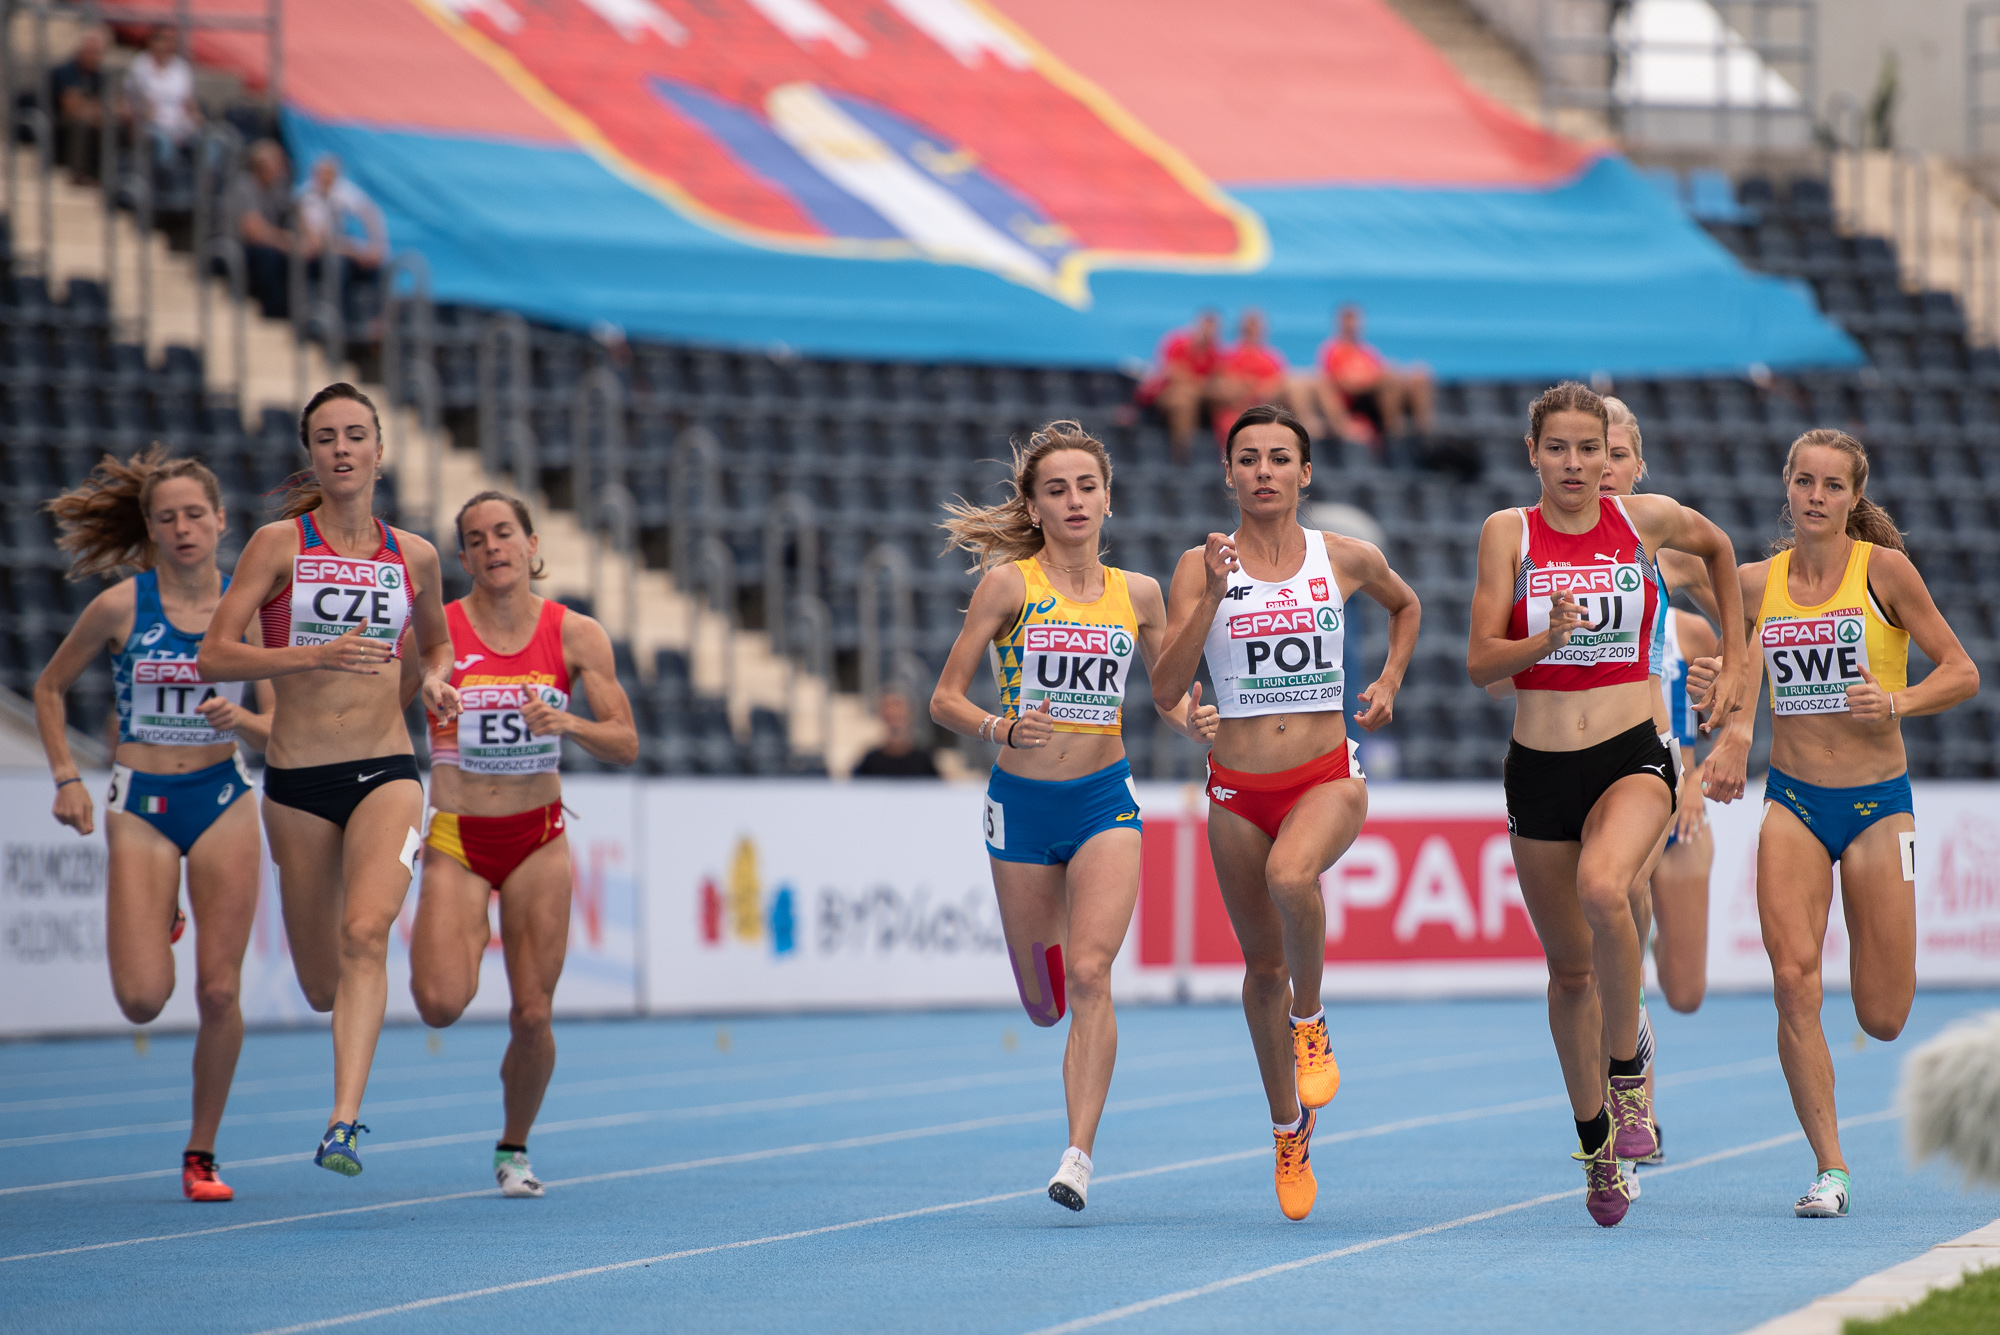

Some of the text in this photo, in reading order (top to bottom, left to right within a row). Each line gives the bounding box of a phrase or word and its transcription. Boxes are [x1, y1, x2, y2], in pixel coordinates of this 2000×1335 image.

[298, 562, 375, 584] SPAR
[1531, 571, 1611, 594] SPAR
[312, 587, 391, 624] CZE
[1578, 595, 1623, 632] UI
[321, 625, 344, 635] RUN
[1232, 611, 1313, 635] SPAR
[1029, 630, 1106, 651] SPAR
[1567, 636, 1584, 645] UN
[1764, 623, 1833, 644] SPAR
[1246, 635, 1333, 675] POL
[1608, 647, 1635, 658] 2019
[1037, 655, 1120, 693] UKR
[1773, 646, 1861, 684] SWE
[1263, 677, 1286, 687] RUN
[1790, 686, 1810, 695] RUN
[1050, 692, 1071, 702] RUN
[1239, 686, 1342, 704] BYDGOSZCZ 2019
[1025, 704, 1100, 720] BYGOSZCZ
[160, 718, 182, 726] RUN
[184, 718, 209, 728] CLEA
[136, 729, 211, 741] BYDGOSZCZ
[486, 747, 507, 756] RUN
[464, 759, 534, 770] BYDGOSZCZ
[987, 804, 995, 839] 5
